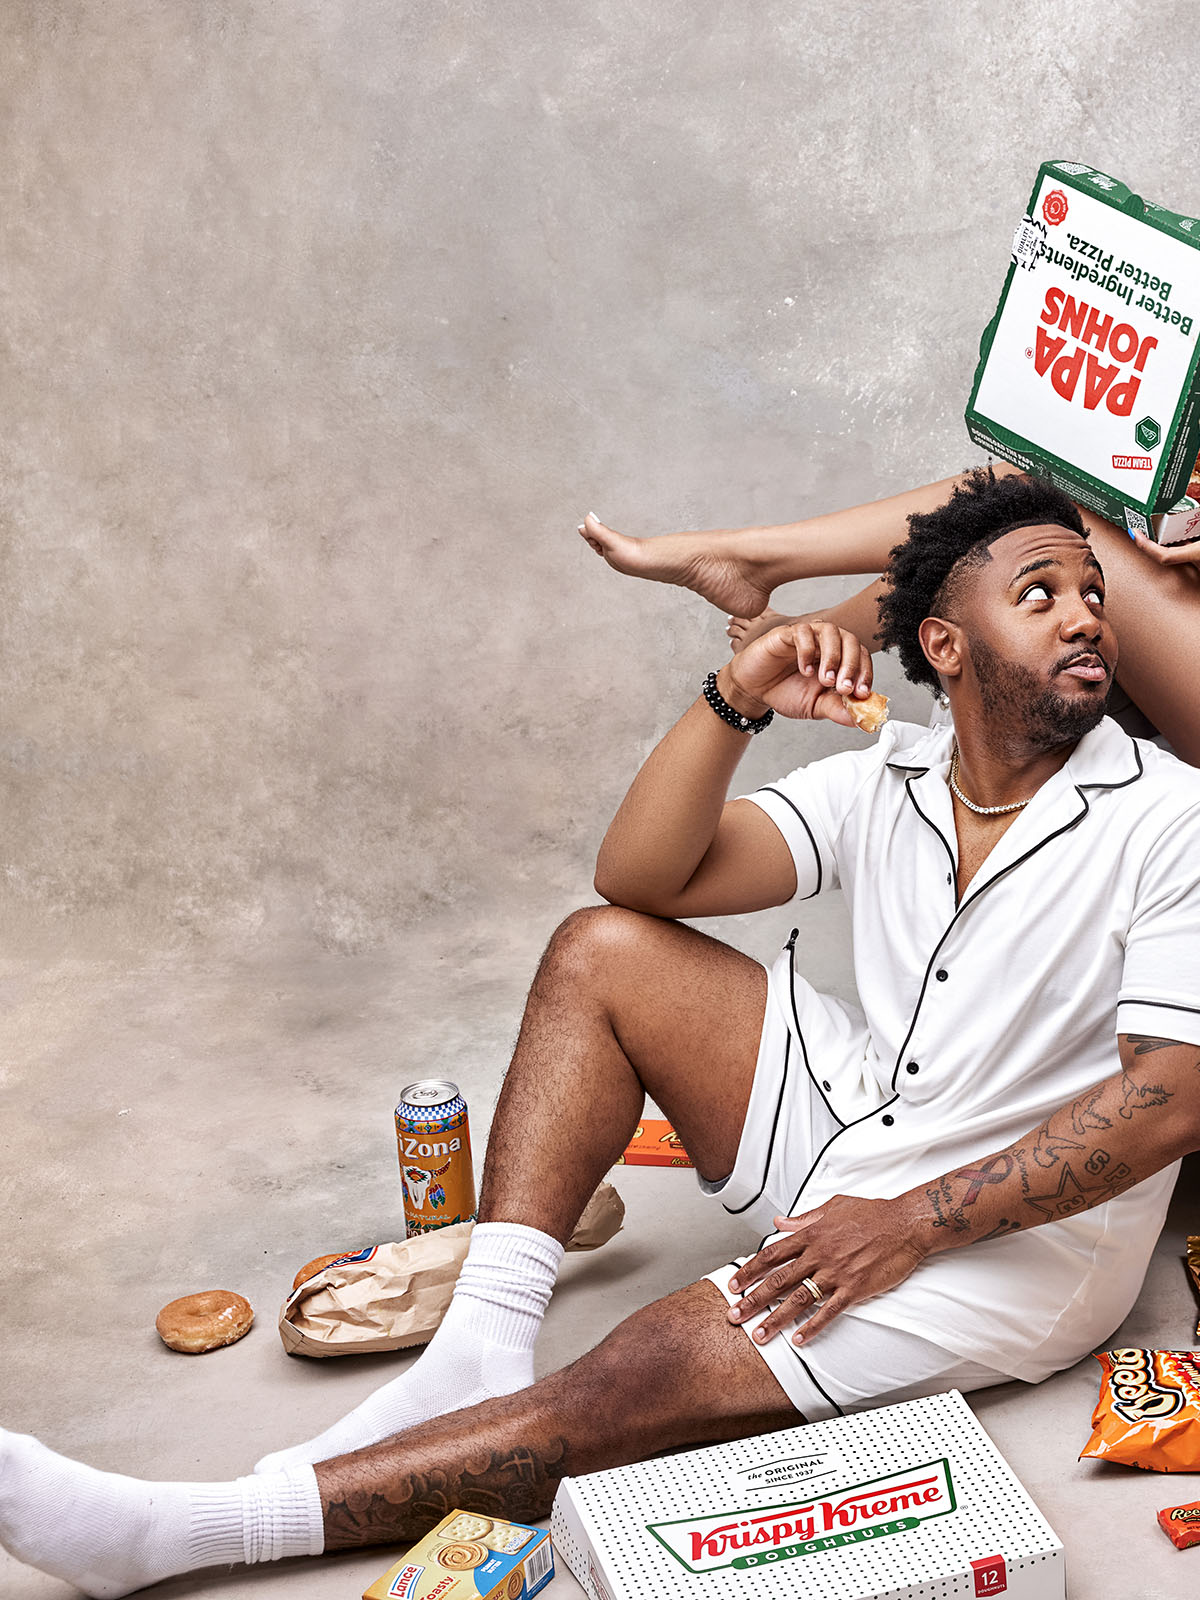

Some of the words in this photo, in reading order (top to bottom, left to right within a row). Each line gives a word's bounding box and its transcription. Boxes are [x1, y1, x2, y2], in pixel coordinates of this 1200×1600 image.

[1017, 227, 1030, 254] QUALITY
[1066, 233, 1111, 271] Pizza.
[1038, 242, 1131, 306] Ingredients
[1114, 256, 1172, 301] Better
[1040, 287, 1158, 372] JOHNS
[1134, 298, 1194, 336] Better
[1034, 325, 1141, 417] PAPA
[1113, 456, 1132, 468] PIZZA
[1132, 457, 1152, 469] TEAM
[398, 1133, 461, 1159] iZona
[1012, 1148, 1030, 1193] Survivor
[926, 1189, 950, 1229] Strong
[1110, 1349, 1183, 1422] Cheeto
[764, 1459, 824, 1476] ORIGINAL
[764, 1473, 794, 1484] SINCE
[795, 1469, 814, 1478] 1937
[688, 1506, 817, 1561] Krispy
[819, 1474, 943, 1530] Kreme
[745, 1520, 907, 1567] DOUGHNUTS
[390, 1567, 417, 1599] Lance
[981, 1570, 999, 1586] 12
